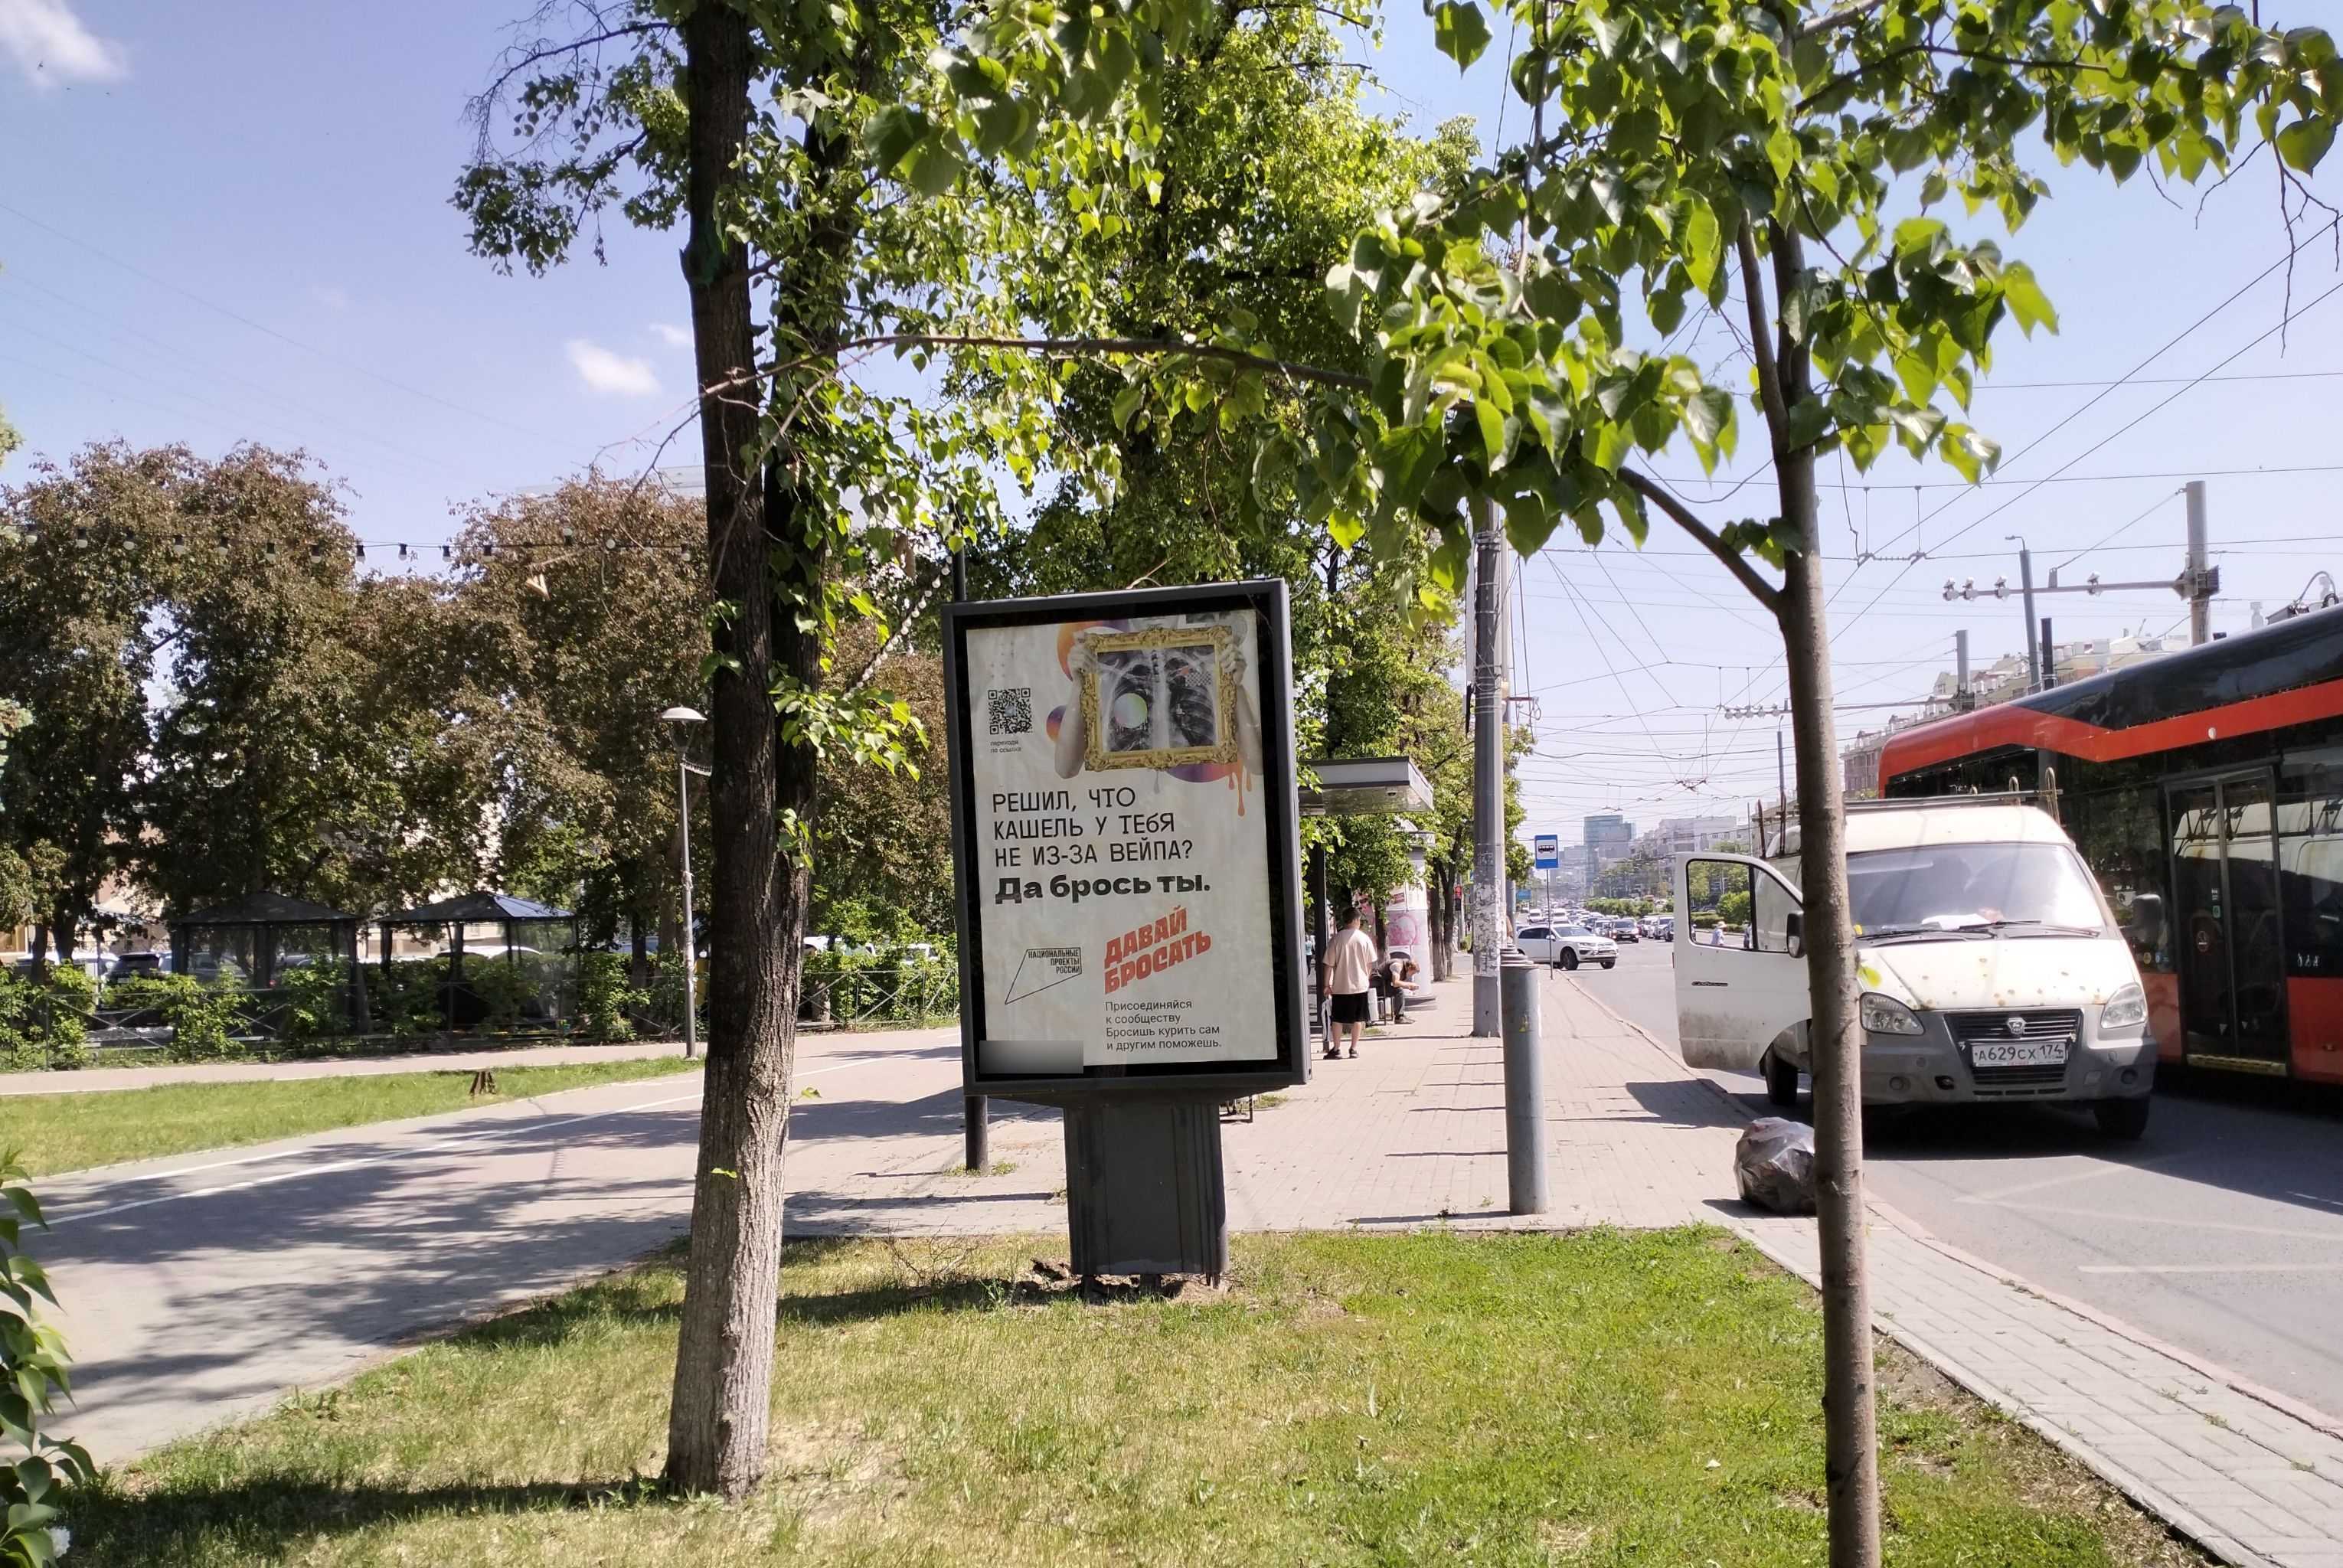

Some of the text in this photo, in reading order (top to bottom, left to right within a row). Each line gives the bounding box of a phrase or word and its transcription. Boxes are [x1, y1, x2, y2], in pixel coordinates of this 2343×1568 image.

[992, 787, 1136, 812] РЕШИЛ, ЧТО
[994, 818, 1083, 840] КАШЕЛЬ
[1096, 816, 1107, 835] У
[995, 838, 1193, 867] НЕ ИЗ-ЗА ВЕЙПА?
[995, 874, 1211, 904] Да брось ты.
[1104, 905, 1187, 969] ДАВАЙ
[1028, 949, 1079, 959] НАЦИОНАЛЬНЫЕ
[1104, 931, 1211, 995] БРОСАТЬ
[1106, 1000, 1192, 1013] Присоединяйся
[1106, 1027, 1155, 1039] Бросишь
[1158, 1027, 1195, 1037] курить
[1116, 1042, 1155, 1052] другим
[1158, 1039, 1222, 1049] поможешь.
